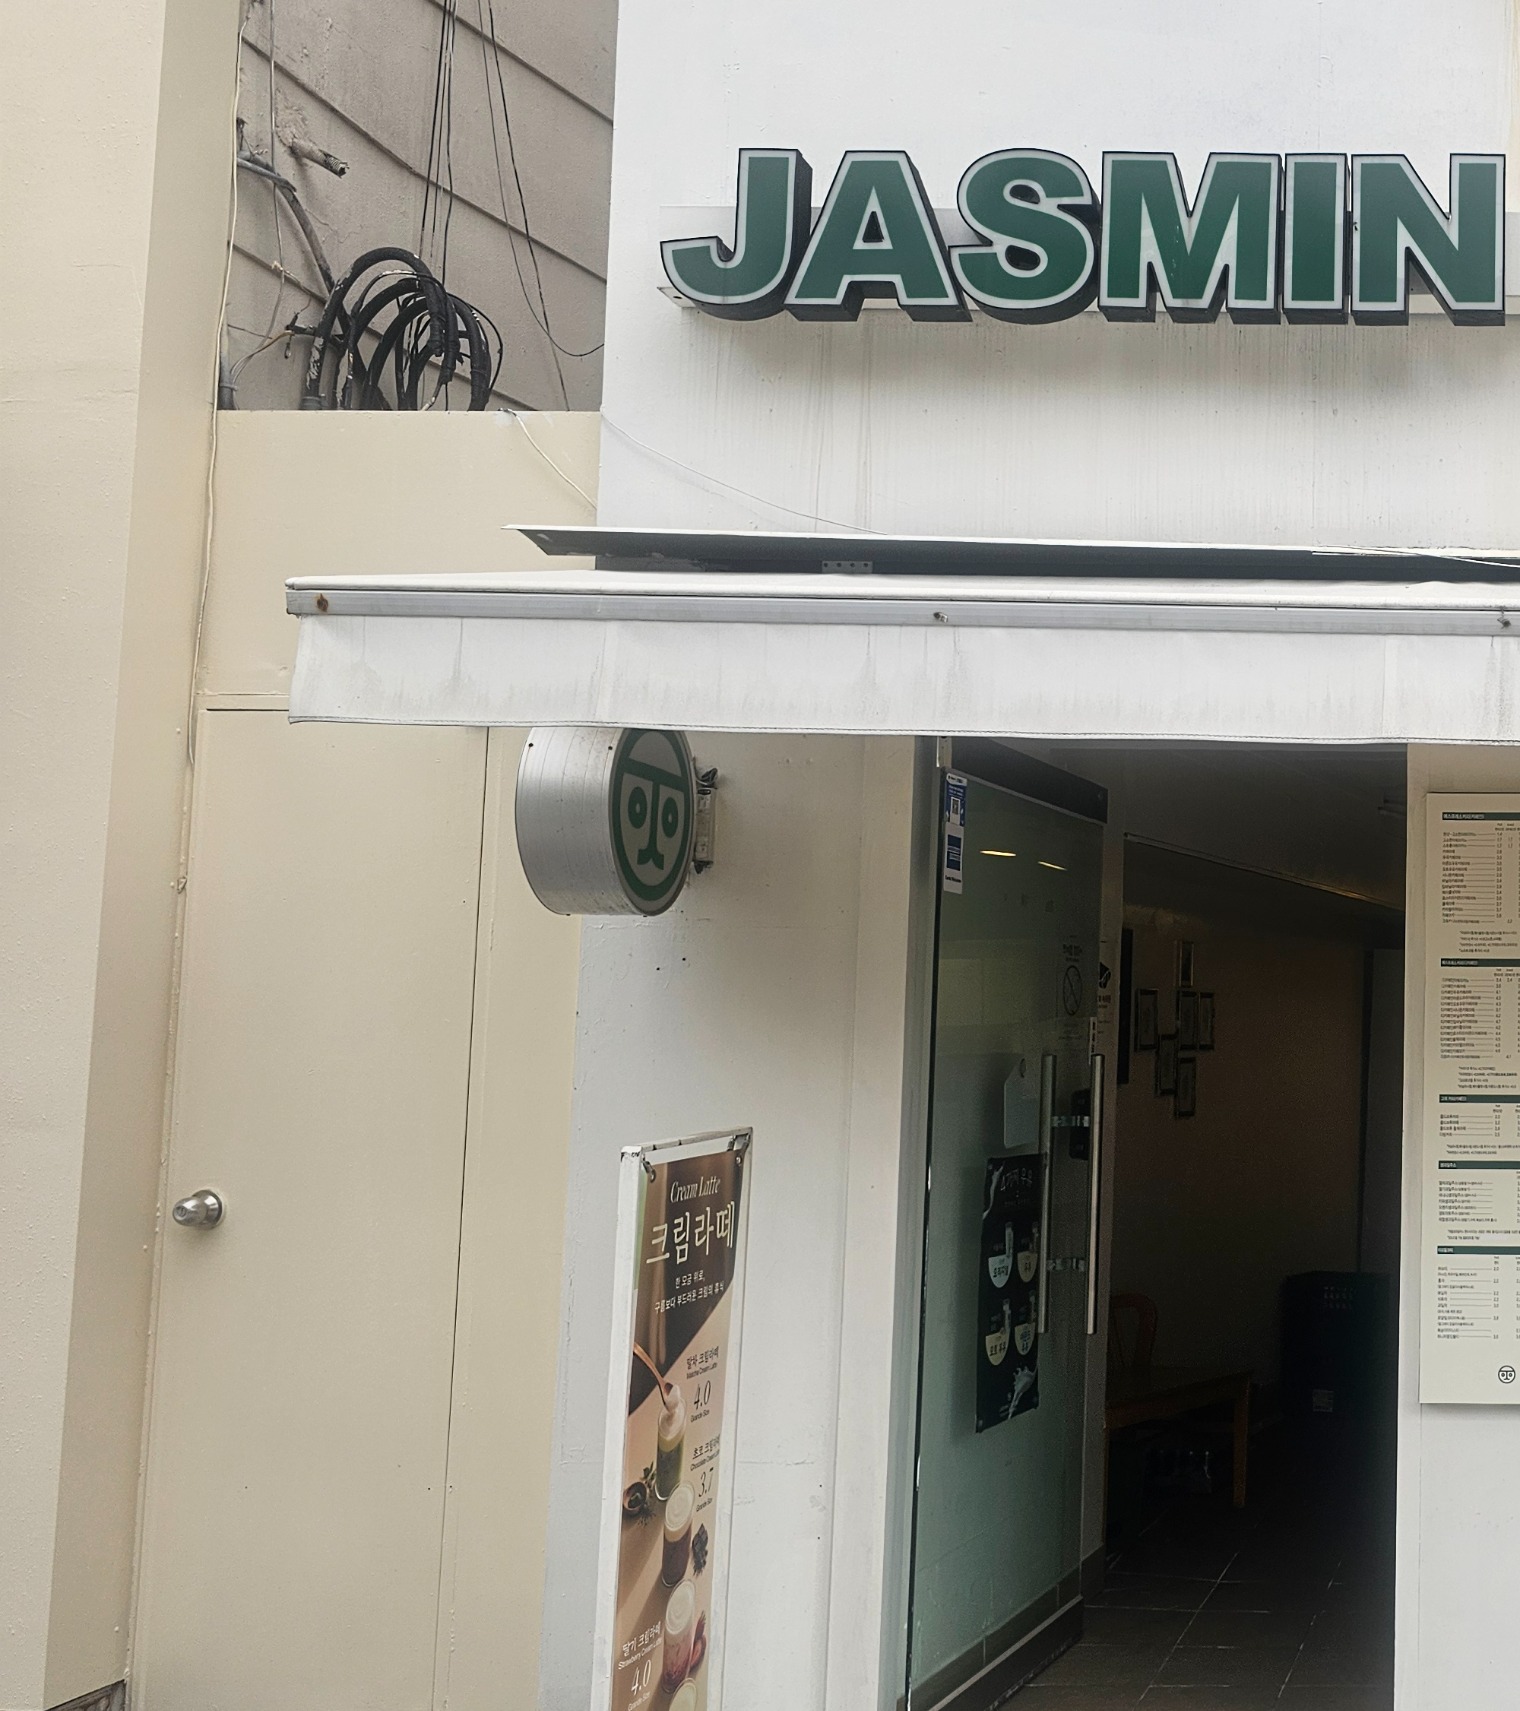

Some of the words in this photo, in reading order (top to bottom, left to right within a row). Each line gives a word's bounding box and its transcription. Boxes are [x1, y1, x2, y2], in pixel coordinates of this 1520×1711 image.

[660, 148, 1506, 325] JASMIN
[670, 1181, 698, 1203] Cream
[699, 1176, 720, 1197] Latte
[646, 1201, 735, 1265] 크림라떼
[694, 1380, 711, 1410] 4.0
[699, 1467, 714, 1497] 3.7
[631, 1659, 651, 1696] 4.0
